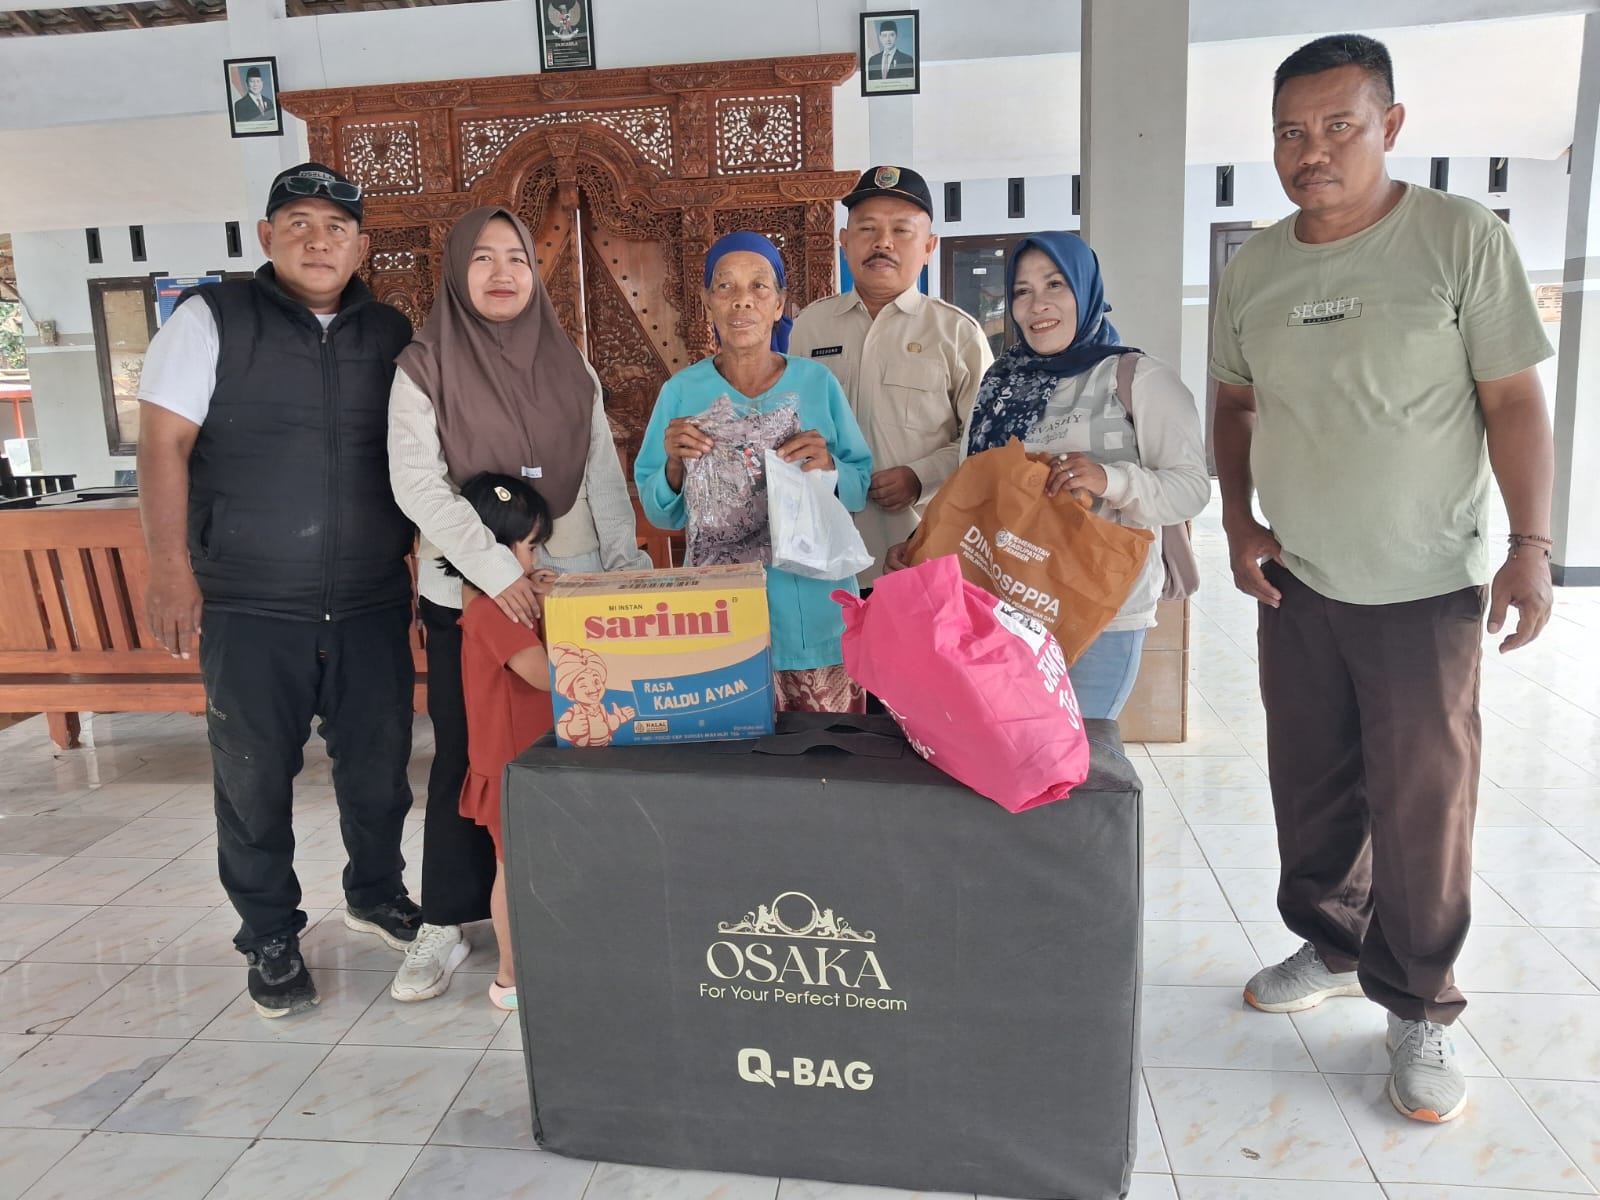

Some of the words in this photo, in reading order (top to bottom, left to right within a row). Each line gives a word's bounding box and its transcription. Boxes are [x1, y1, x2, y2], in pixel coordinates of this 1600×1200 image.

[1291, 297, 1360, 319] SECRET
[963, 525, 1060, 617] DINOSPPPA
[584, 599, 731, 640] sarimi
[1037, 634, 1067, 693] JEMB
[643, 681, 674, 694] RASA
[654, 693, 700, 710] KALDU
[705, 679, 749, 703] AYAM
[706, 941, 892, 991] OSAKA
[700, 983, 726, 999] For
[730, 985, 769, 1002] Your
[774, 988, 840, 1007] Perfect
[846, 993, 907, 1011] Dream
[737, 1047, 874, 1091] Q-BAG
